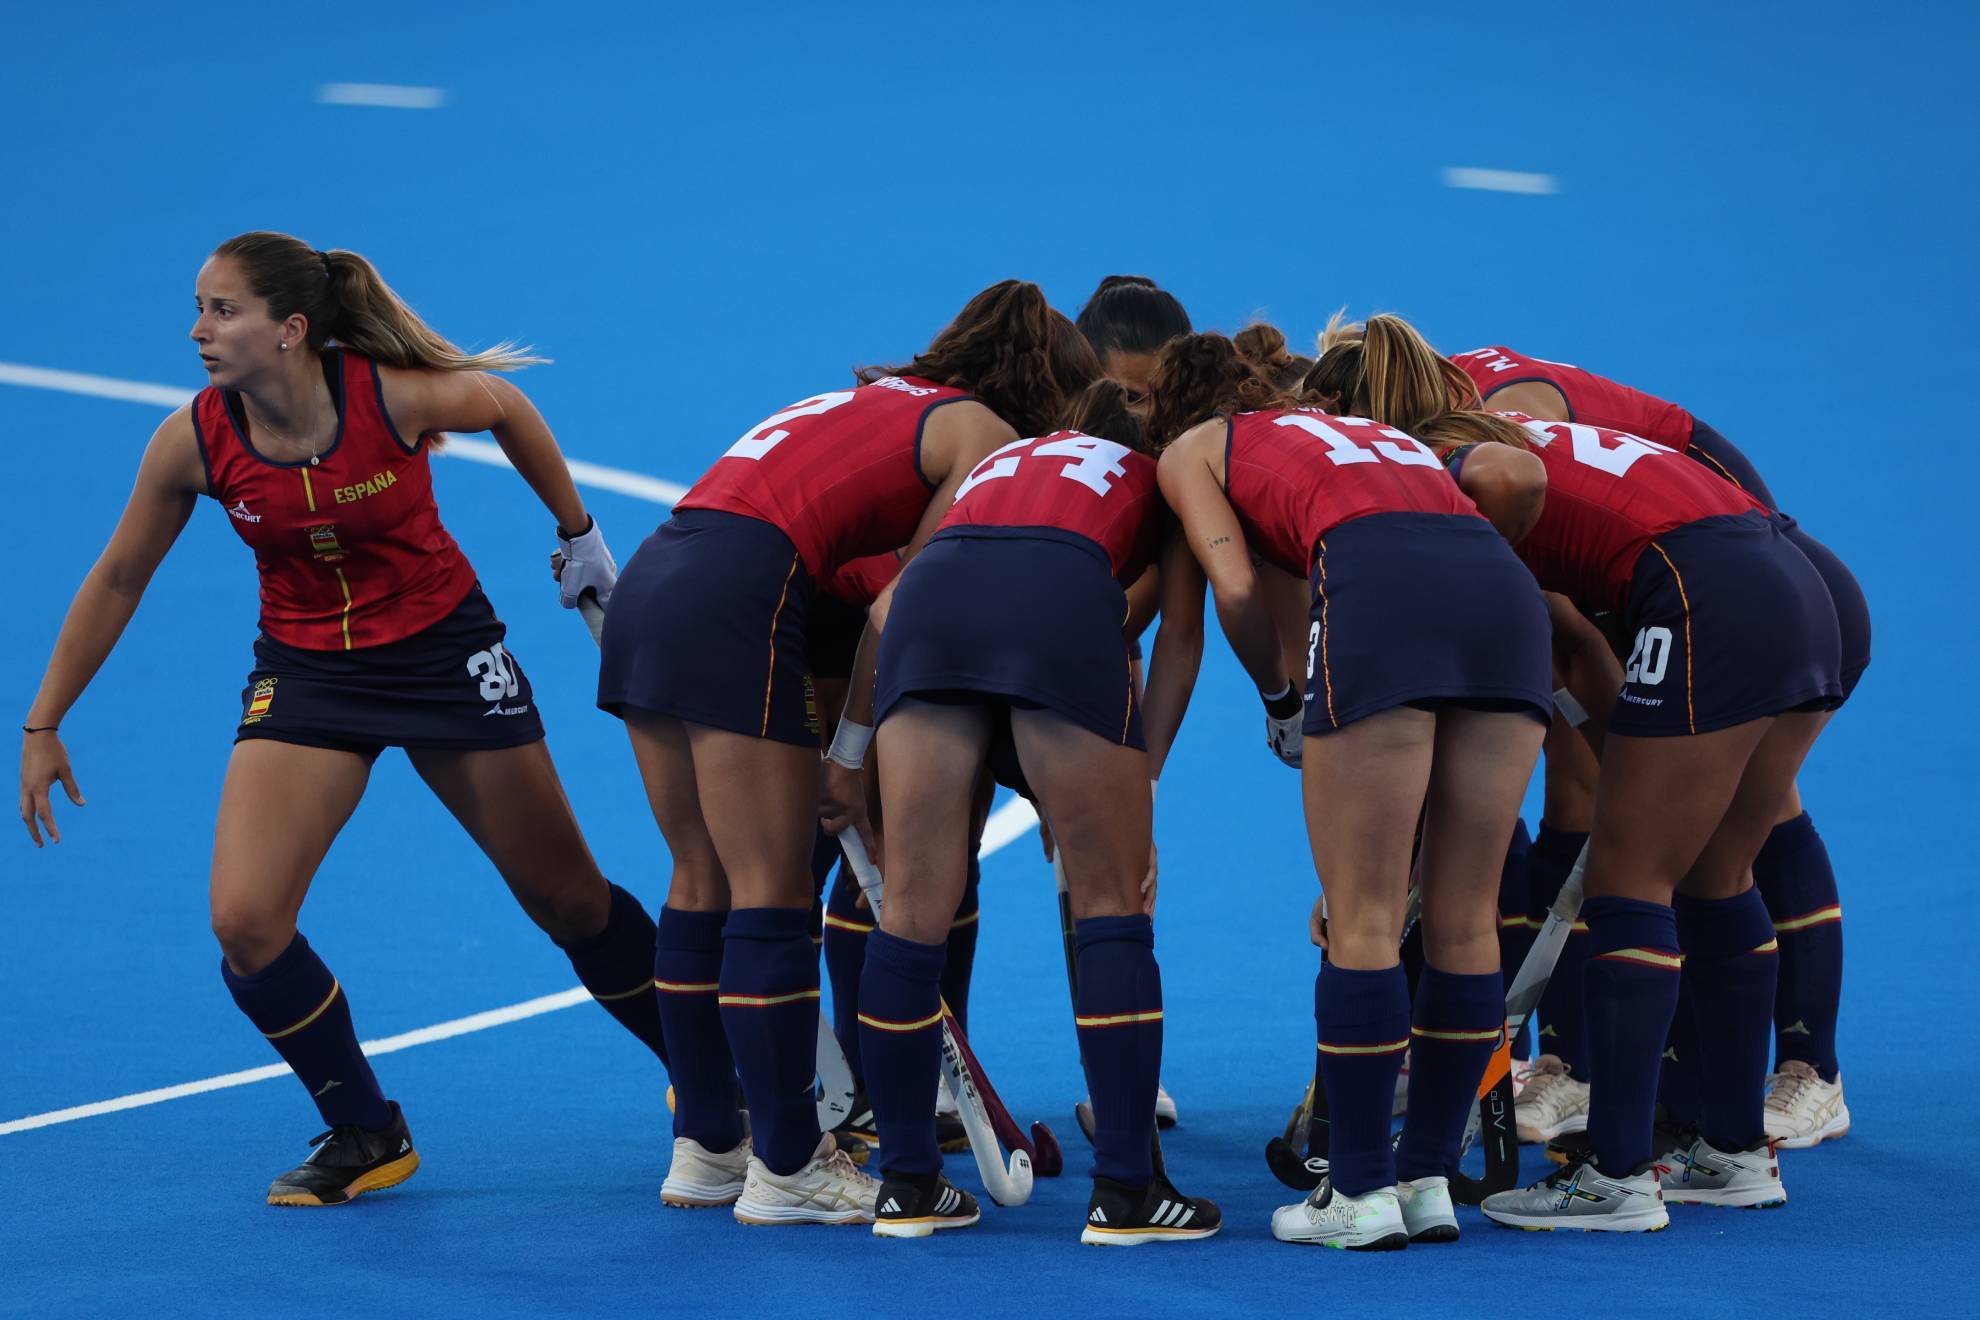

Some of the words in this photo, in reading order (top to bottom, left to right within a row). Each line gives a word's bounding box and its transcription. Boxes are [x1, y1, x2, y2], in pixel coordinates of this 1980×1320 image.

[953, 436, 1133, 505] 24
[1273, 414, 1445, 471] 13
[334, 470, 397, 504] ESPAÑA
[466, 642, 519, 701] 30
[1625, 626, 1673, 685] 20
